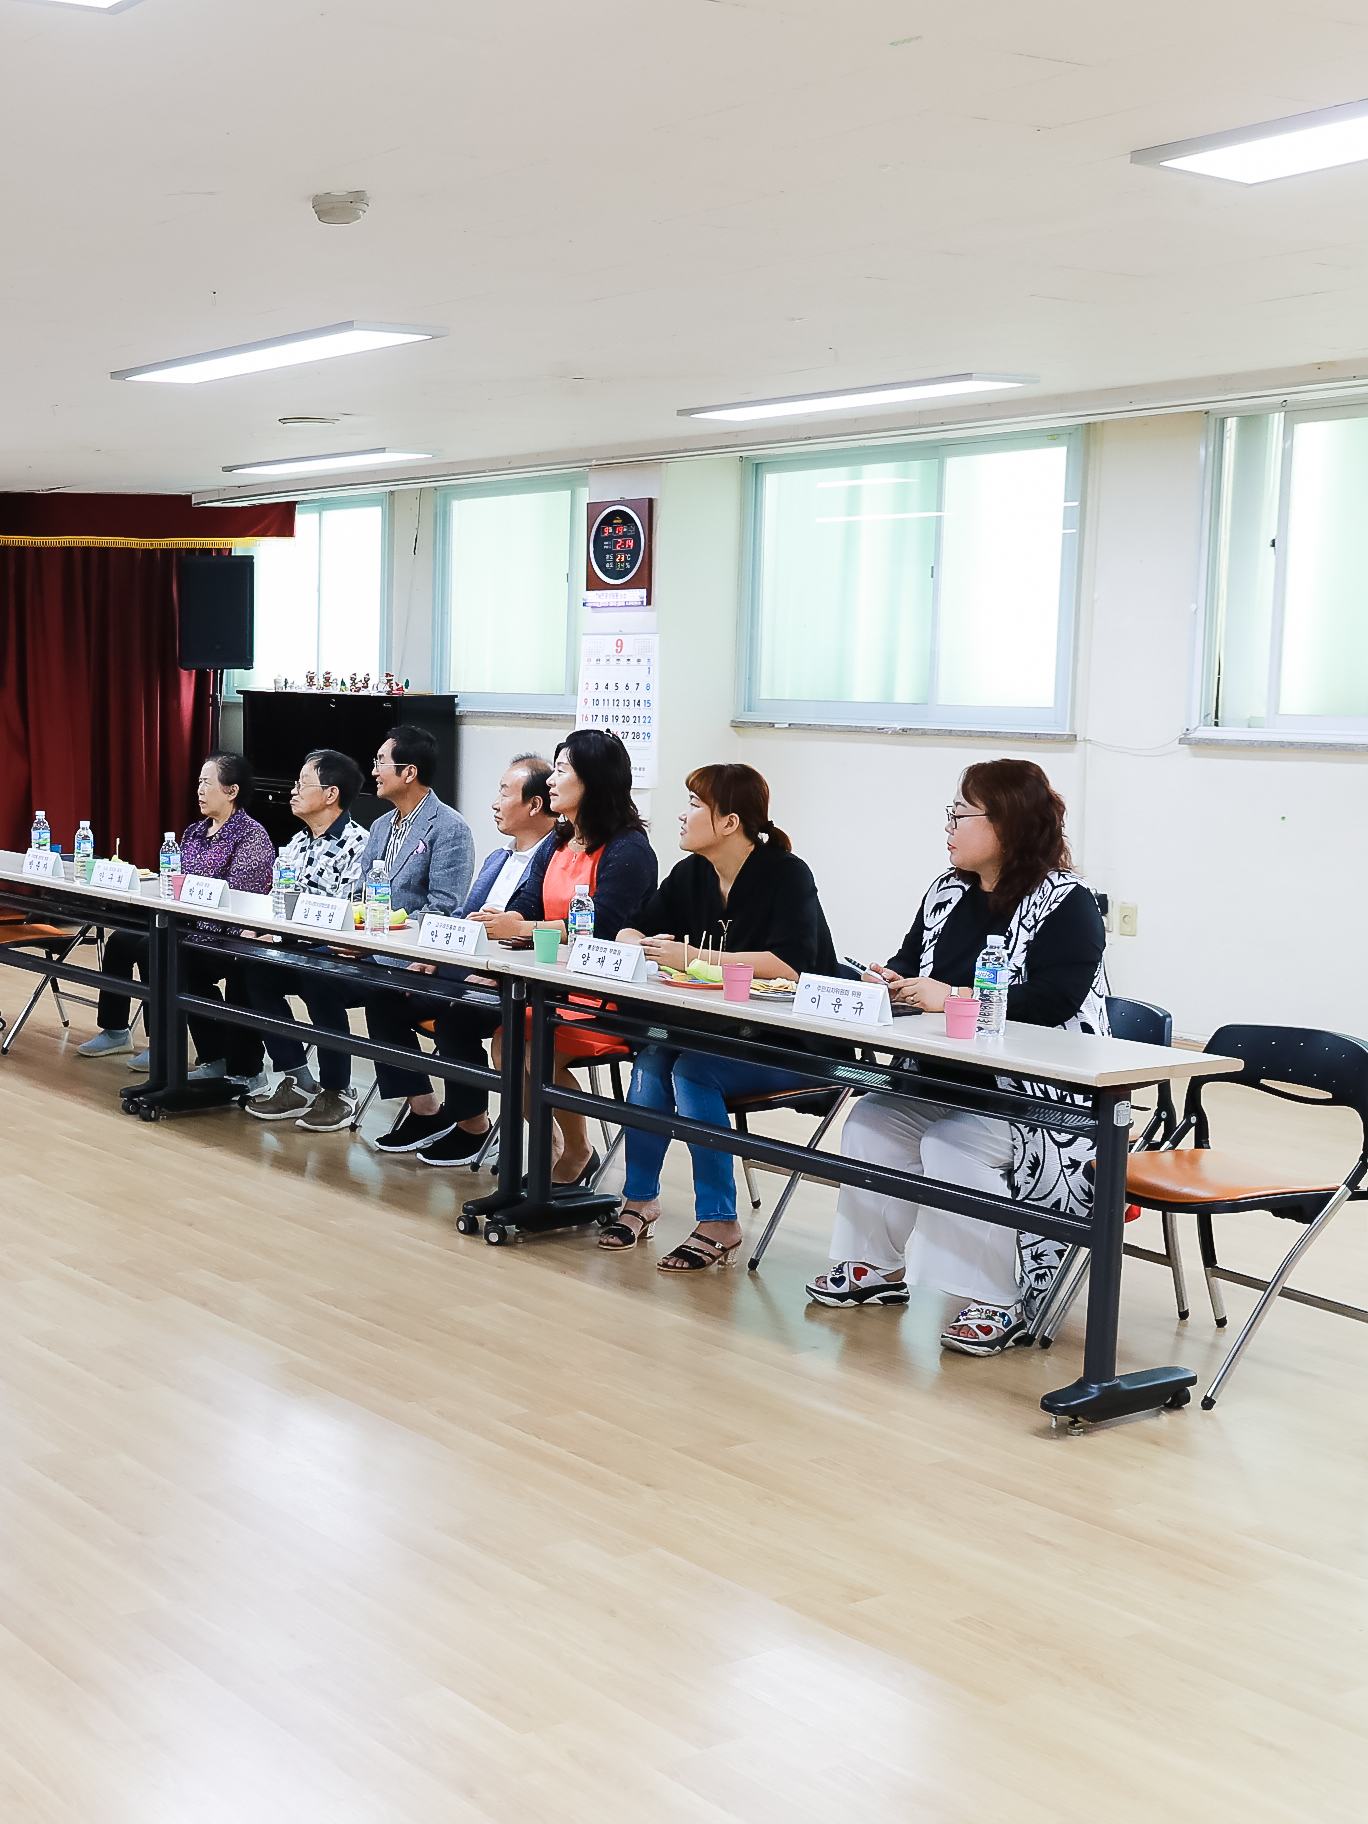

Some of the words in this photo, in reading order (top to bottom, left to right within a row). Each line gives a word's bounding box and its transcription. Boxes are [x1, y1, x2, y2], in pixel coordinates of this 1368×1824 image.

[615, 638, 624, 654] 9
[585, 682, 589, 690] 2
[595, 682, 598, 690] 3
[605, 682, 608, 691] 4
[615, 682, 619, 691] 5
[625, 683, 629, 691] 6
[636, 683, 640, 691] 7
[646, 683, 650, 691] 8
[431, 930, 466, 947] 안정미
[582, 952, 622, 972] 양재심
[817, 985, 851, 996] 주민자치위원회
[810, 994, 864, 1017] 이윤규
